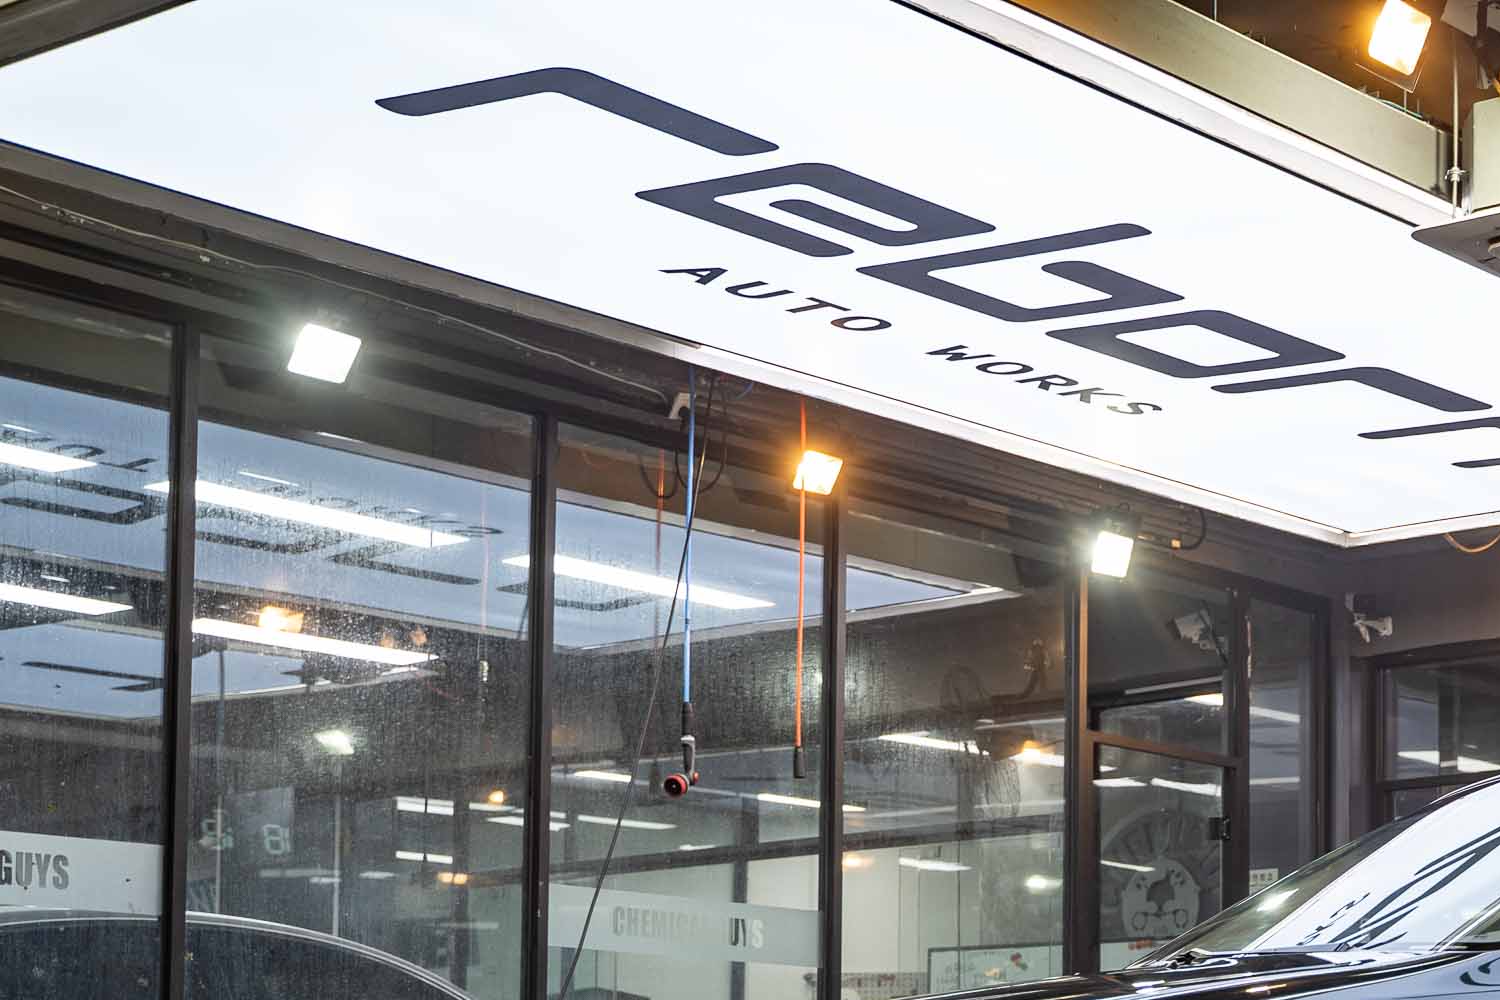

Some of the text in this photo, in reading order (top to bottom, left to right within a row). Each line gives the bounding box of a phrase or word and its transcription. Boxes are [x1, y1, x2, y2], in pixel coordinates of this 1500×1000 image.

[658, 267, 1162, 415] AUTO WORKS
[0, 848, 70, 891] GUYS
